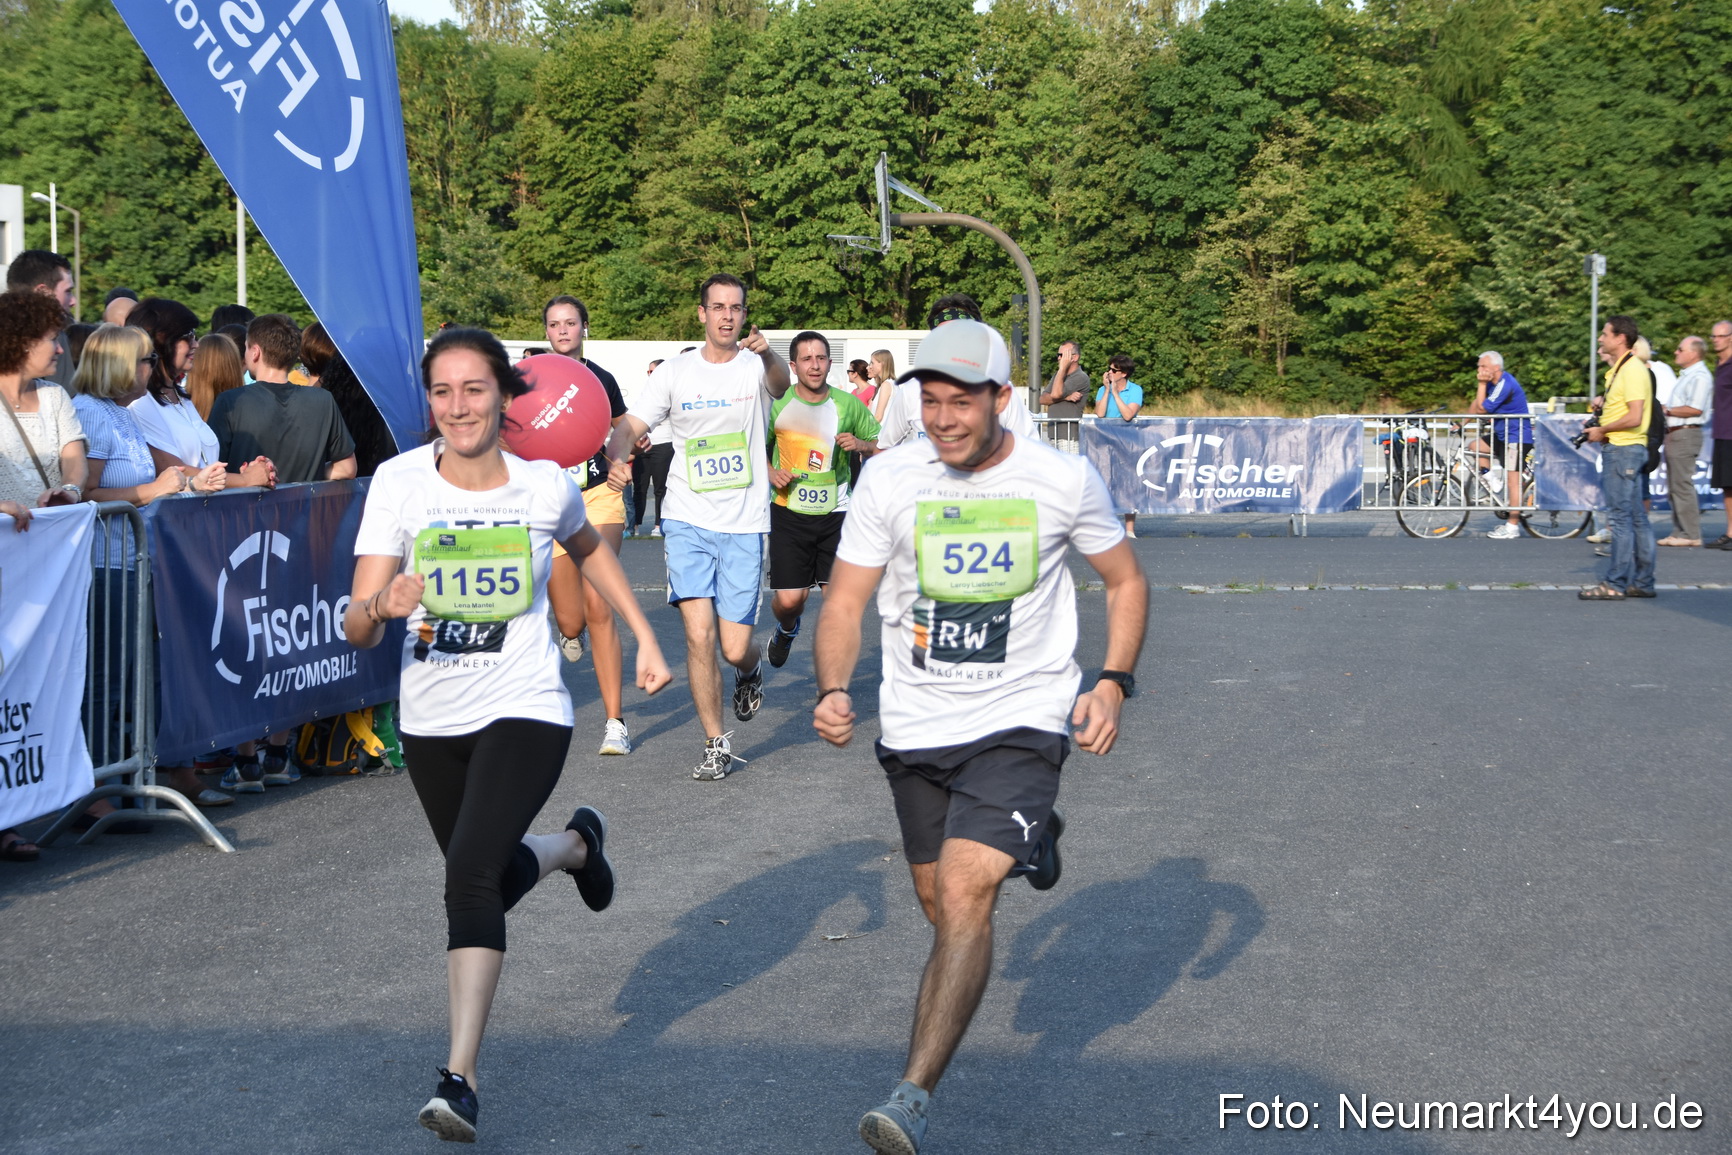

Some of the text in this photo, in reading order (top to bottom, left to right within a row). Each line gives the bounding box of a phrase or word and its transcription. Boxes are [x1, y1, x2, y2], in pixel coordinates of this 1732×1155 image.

[693, 454, 744, 477] 1303
[1166, 458, 1303, 484] Fischer
[798, 488, 828, 503] 993
[937, 489, 960, 498] NEUE
[1178, 486, 1292, 499] AUTOMOBILE
[473, 506, 530, 516] WOHNFORMEL
[943, 541, 1014, 574] 524
[428, 566, 520, 596] 1155
[243, 584, 352, 662] Fische
[938, 620, 988, 649] RW
[253, 651, 357, 699] AUTOMOBILE
[928, 666, 1004, 679] RAUMWERK
[0, 698, 32, 734] ter
